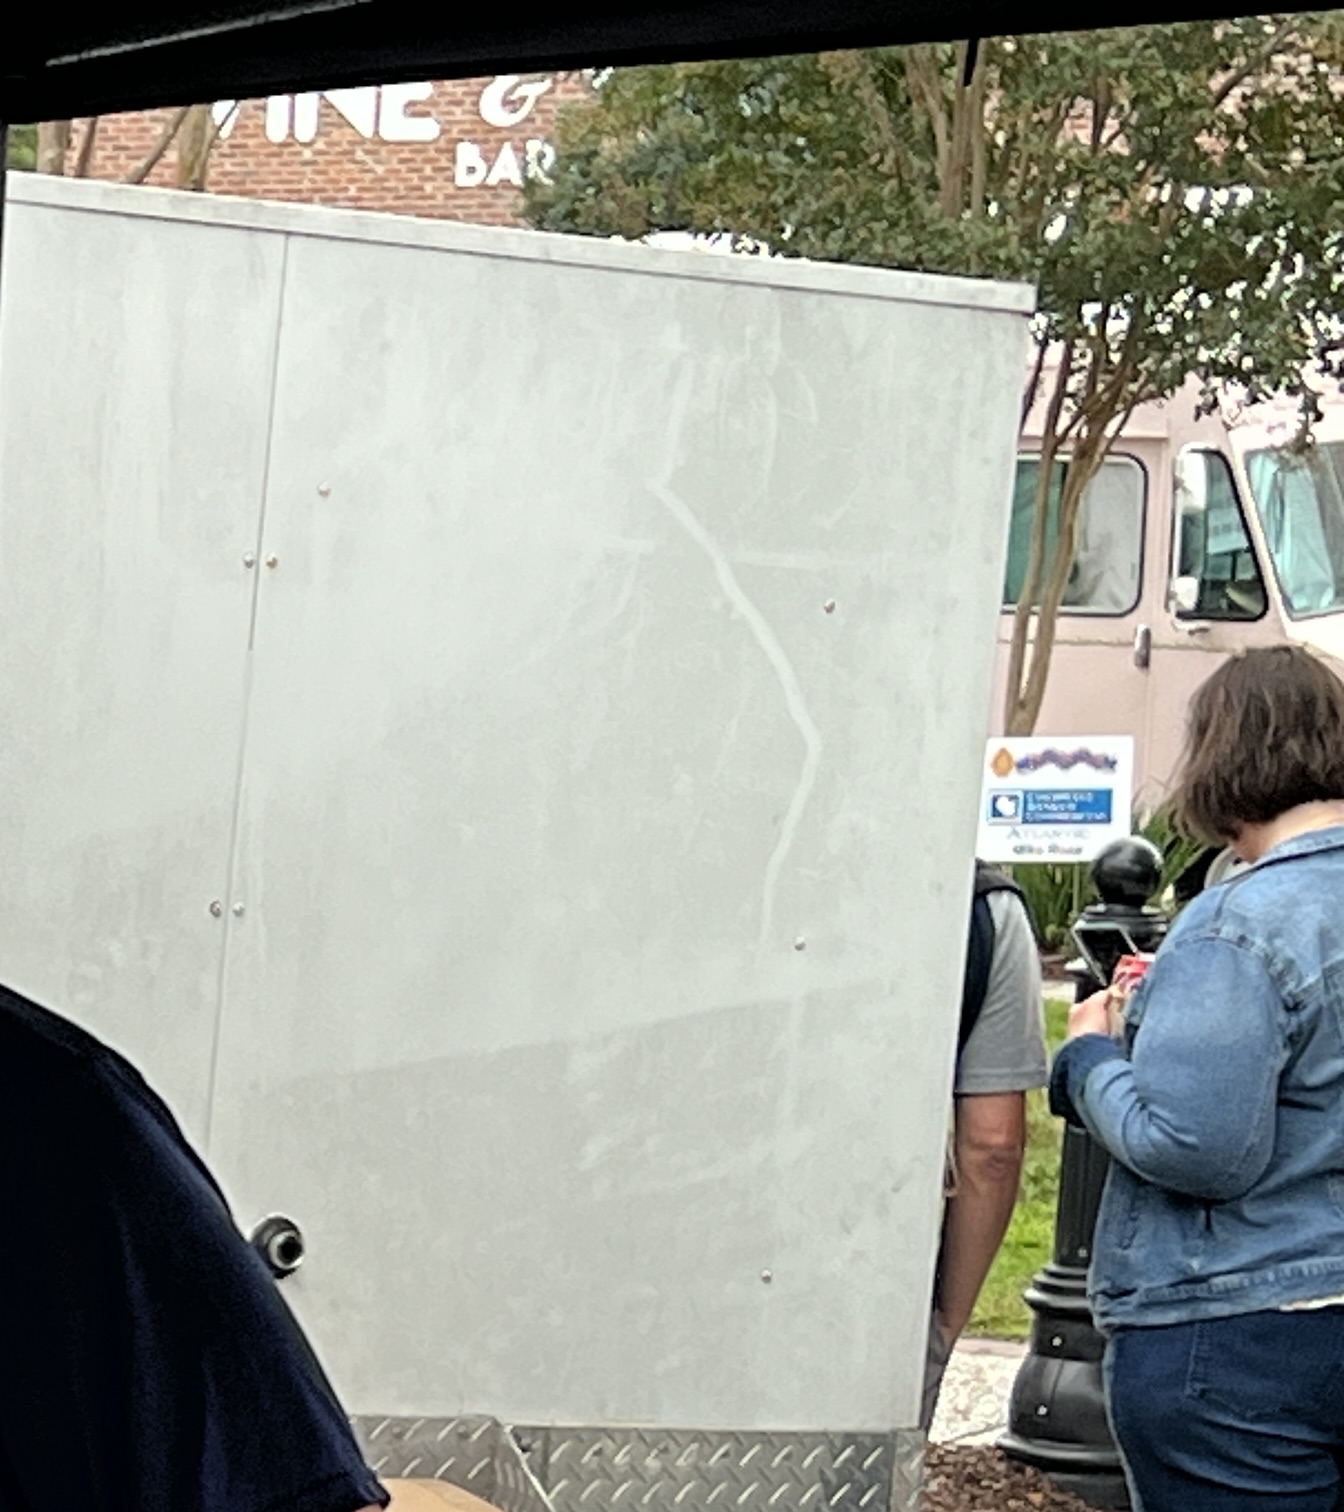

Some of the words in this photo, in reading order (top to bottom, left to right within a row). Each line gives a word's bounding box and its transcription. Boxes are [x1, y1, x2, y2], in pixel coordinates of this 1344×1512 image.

[212, 82, 441, 143] INE
[479, 75, 553, 127] &
[455, 140, 555, 187] BAR
